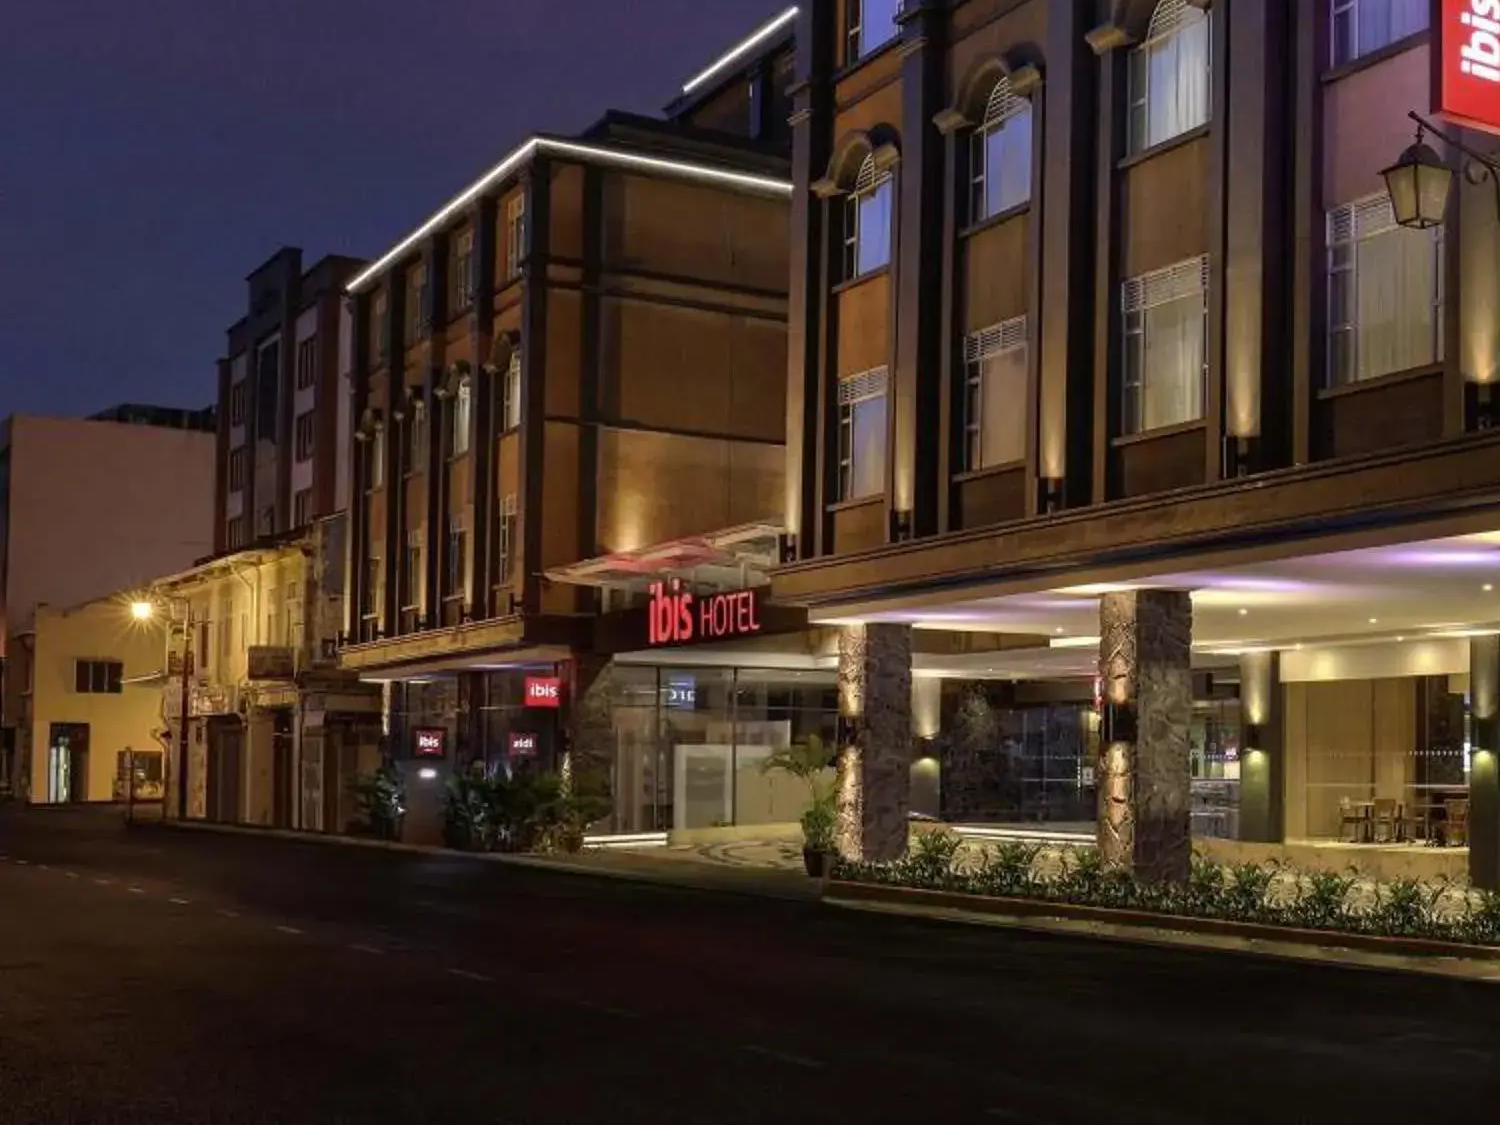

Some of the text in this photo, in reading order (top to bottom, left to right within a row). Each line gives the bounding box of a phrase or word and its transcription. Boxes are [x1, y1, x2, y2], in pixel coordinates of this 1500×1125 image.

[649, 577, 760, 644] ibis HOTEL
[530, 682, 559, 698] ibis
[418, 735, 439, 748] ibis
